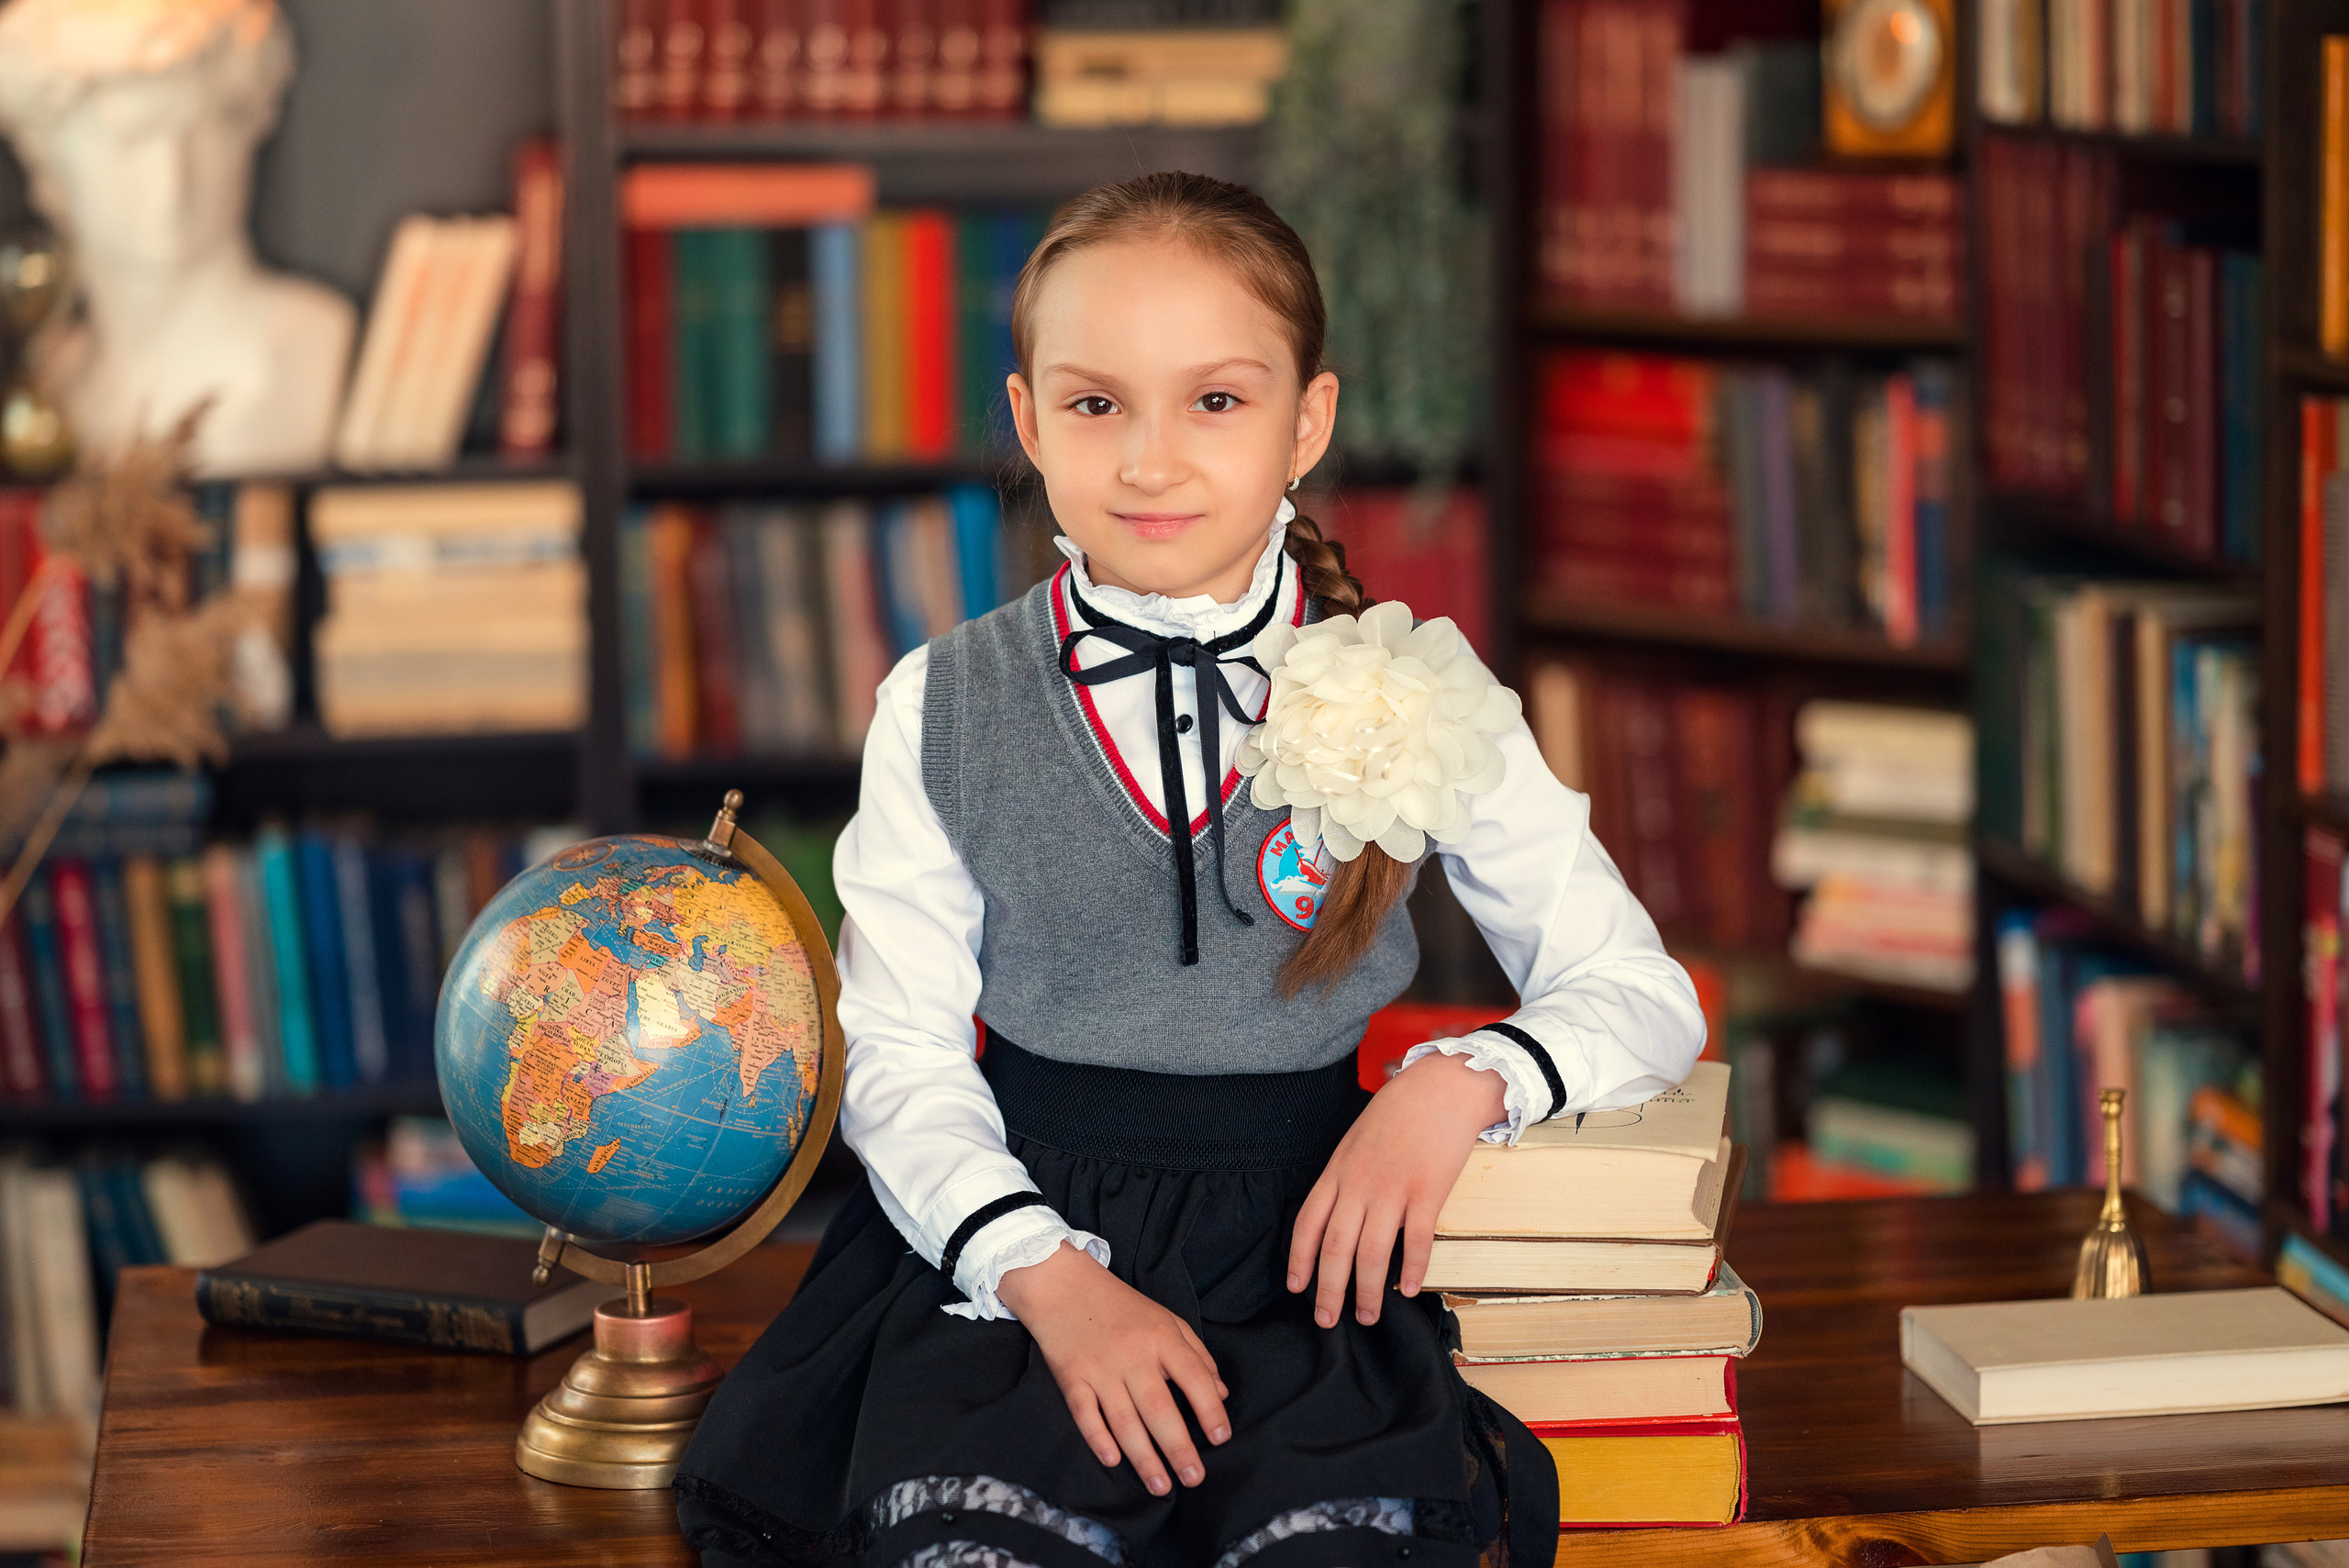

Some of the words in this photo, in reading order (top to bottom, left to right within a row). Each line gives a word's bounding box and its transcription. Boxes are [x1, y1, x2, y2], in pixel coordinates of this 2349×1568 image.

[1295, 895, 1323, 919] 9
[580, 956, 596, 968] LIBYA
[650, 956, 664, 965] SYRIA
[538, 967, 552, 981] NIGER
[602, 976, 622, 989] EGYPT
[562, 986, 576, 996] CHAD
[547, 1024, 564, 1036] CENTRAL
[576, 1036, 595, 1048] SOUTH
[680, 1034, 697, 1046] OMAN
[573, 1041, 591, 1053] SUDAN
[600, 1051, 628, 1068] ETHIOPIA
[630, 1067, 657, 1084] SOMALIA
[593, 1141, 621, 1173] MADAGASCAR
